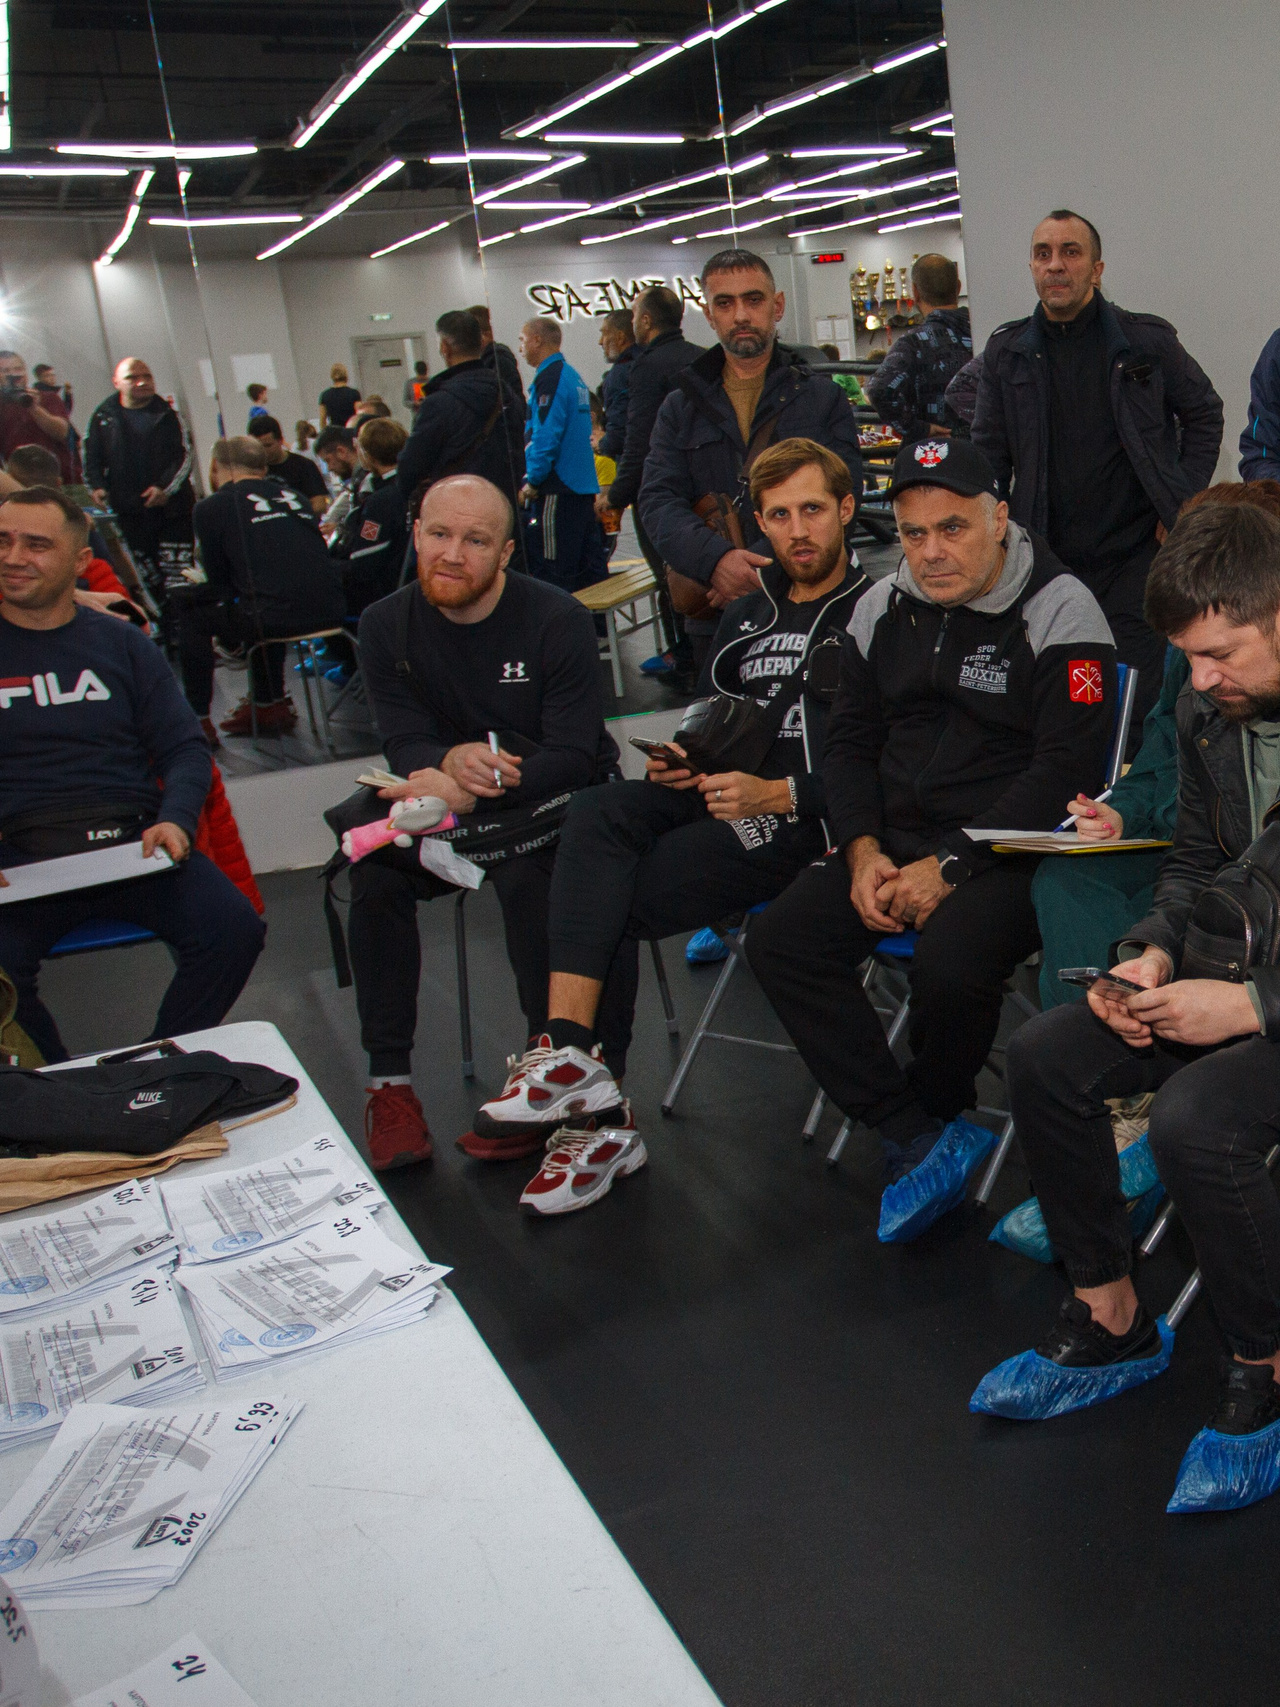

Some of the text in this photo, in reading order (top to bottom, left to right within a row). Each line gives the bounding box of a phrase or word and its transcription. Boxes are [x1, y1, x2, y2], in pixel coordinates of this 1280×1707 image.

[960, 665, 1007, 683] BOXING
[0, 669, 111, 709] FILA
[137, 1091, 163, 1102] NIKE
